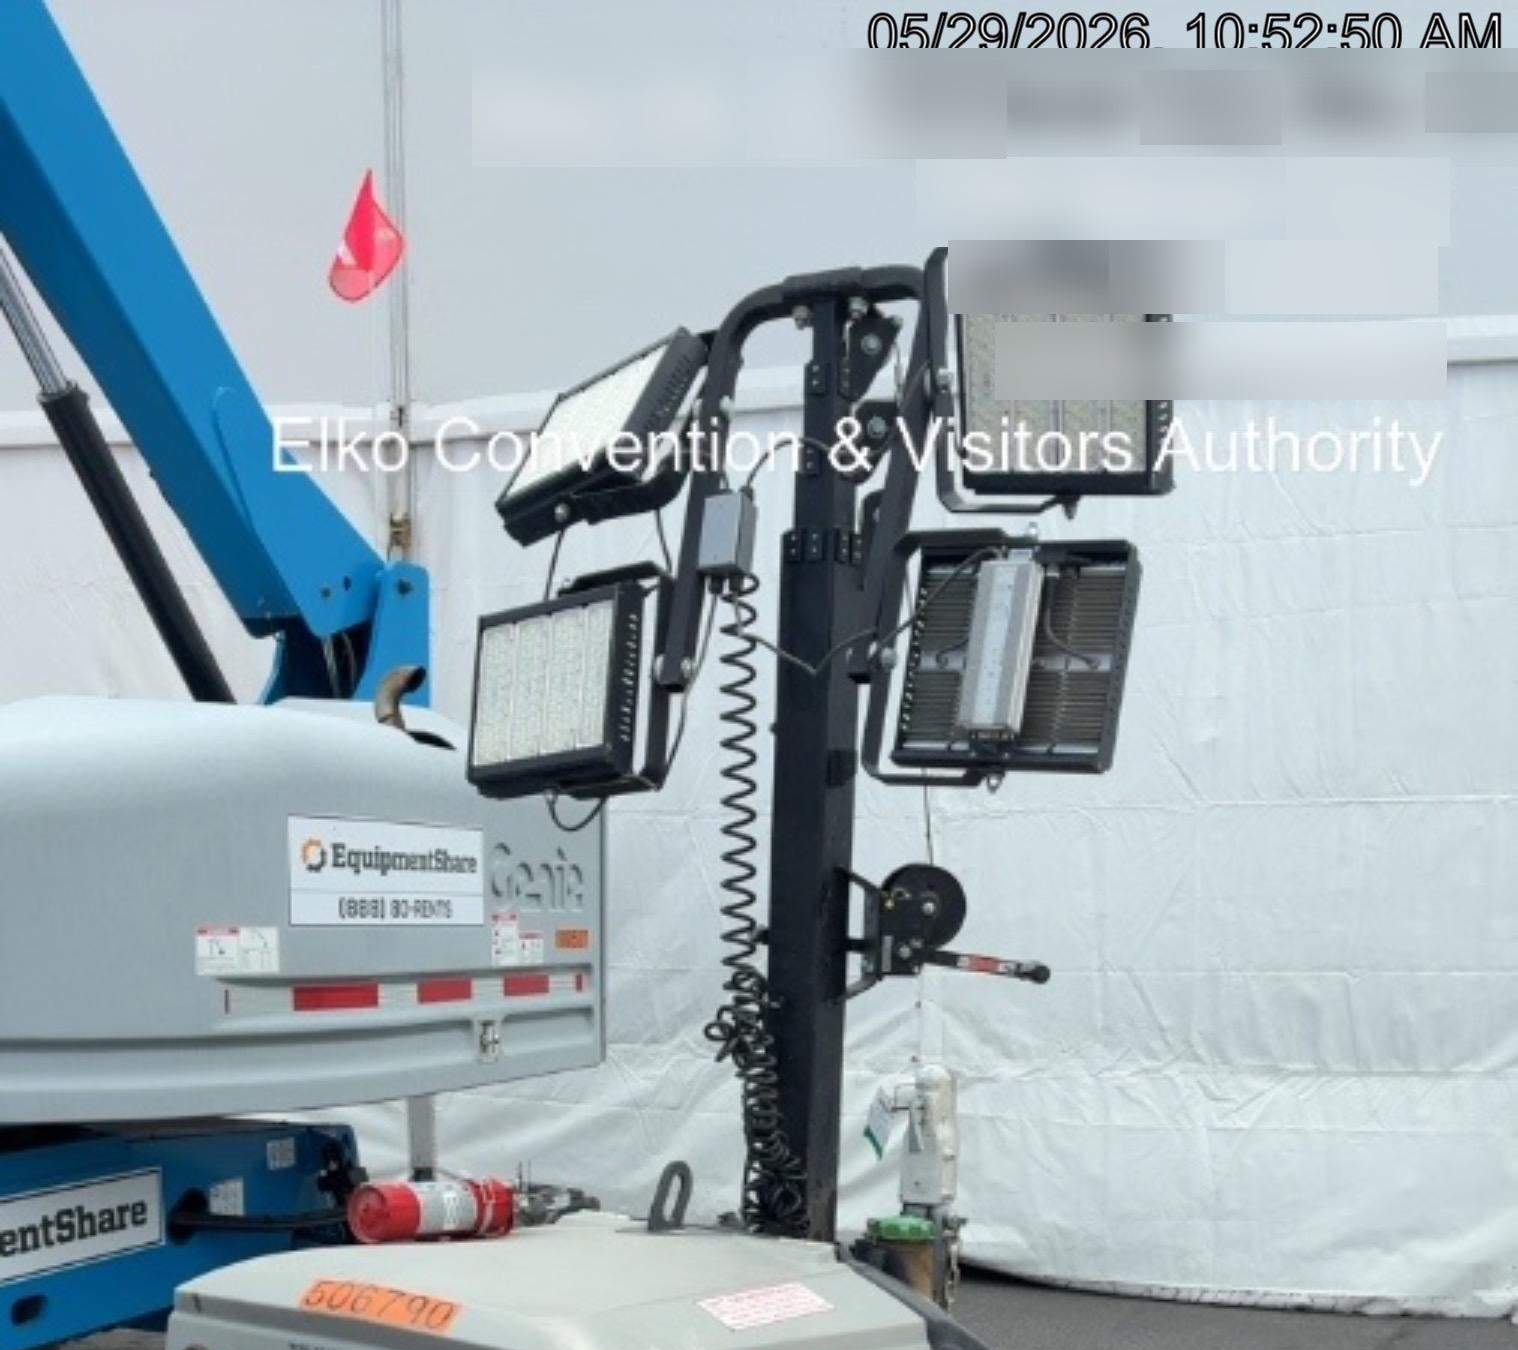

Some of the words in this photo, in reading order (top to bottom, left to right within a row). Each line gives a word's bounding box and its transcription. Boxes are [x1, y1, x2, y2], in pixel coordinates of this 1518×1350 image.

[331, 842, 478, 876] EquipmentShare
[0, 1201, 148, 1257] entShare
[305, 1279, 456, 1329] 506790
